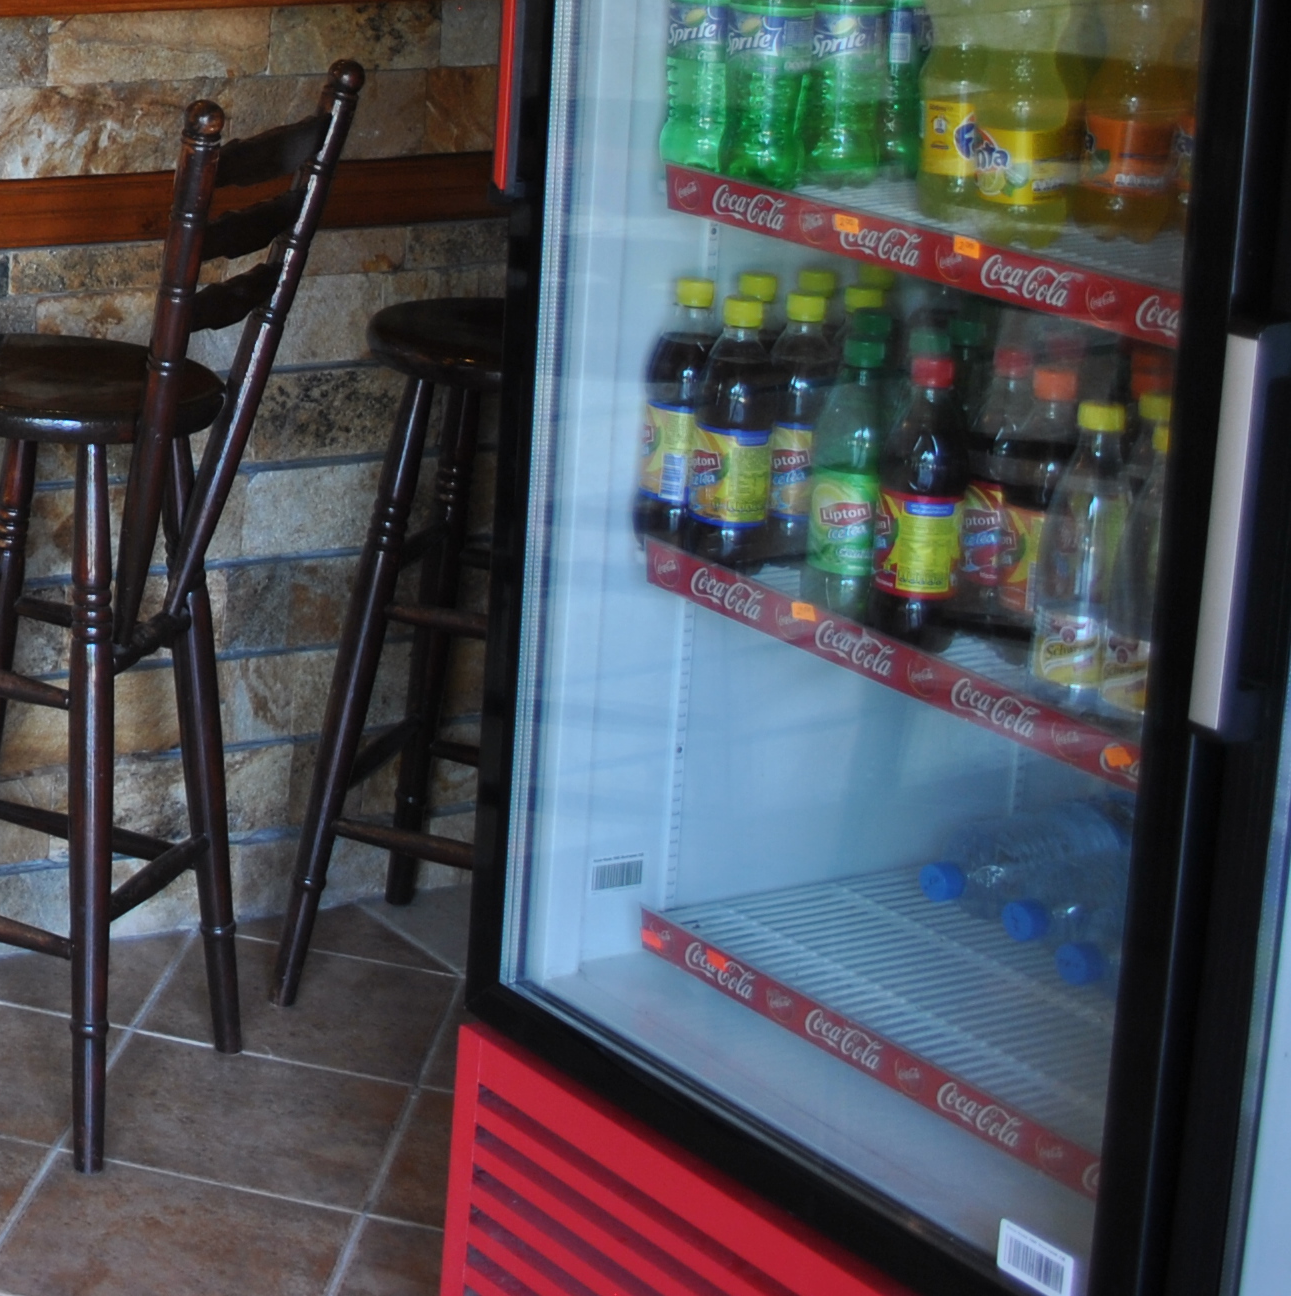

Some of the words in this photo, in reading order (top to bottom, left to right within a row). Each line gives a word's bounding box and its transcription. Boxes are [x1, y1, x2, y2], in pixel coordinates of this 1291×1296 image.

[668, 22, 716, 46] Sprite
[727, 29, 771, 55] Sprite
[812, 30, 866, 55] Sprite
[712, 183, 787, 231] Coca-Cola
[980, 254, 1071, 309] Coca-Cola
[773, 453, 806, 468] pton
[821, 507, 867, 522] Lipton
[690, 567, 766, 622] Coca-Cola
[815, 619, 896, 677] Coca-Cola
[950, 678, 1041, 739] Coca-Cola
[804, 1008, 884, 1071] Coca-Cola
[936, 1081, 1024, 1148] Coca-Cola
